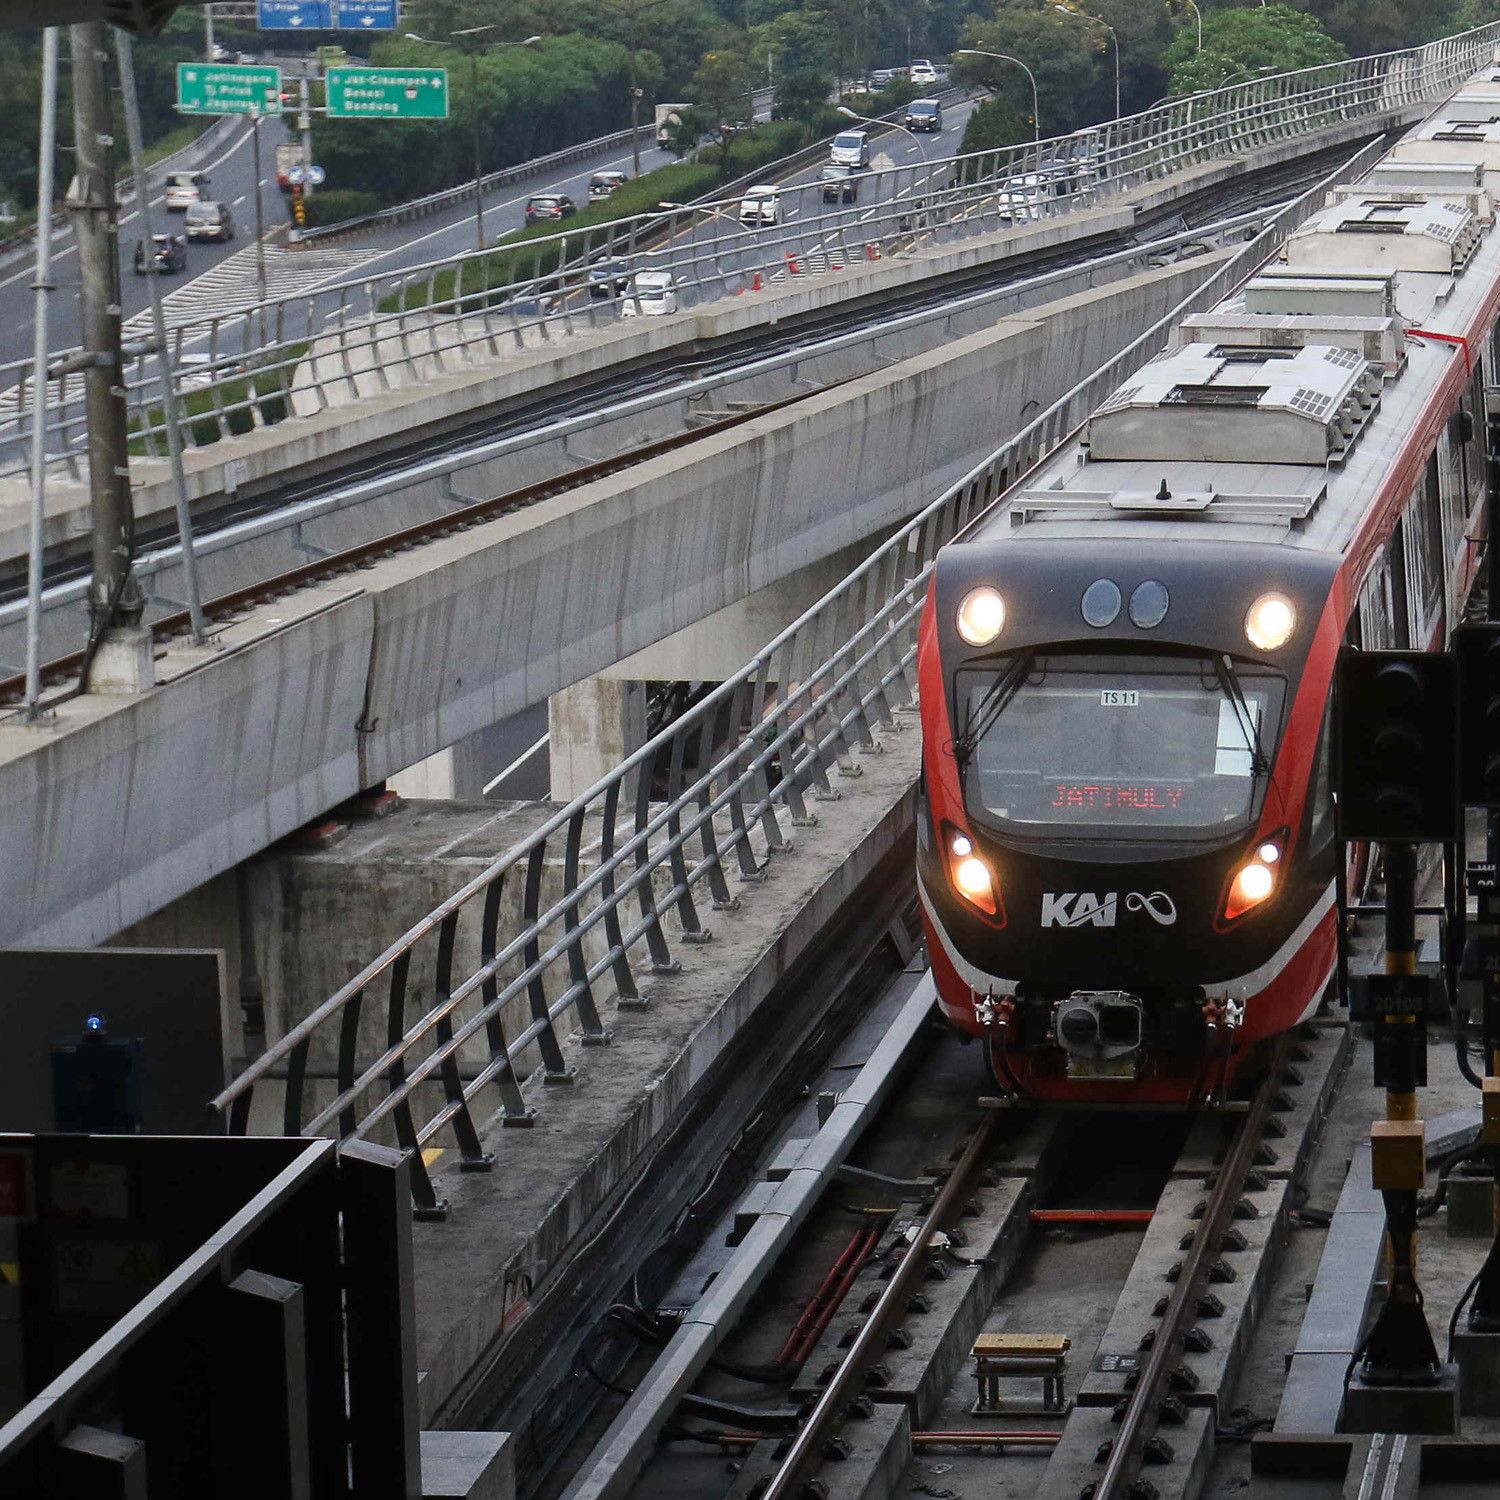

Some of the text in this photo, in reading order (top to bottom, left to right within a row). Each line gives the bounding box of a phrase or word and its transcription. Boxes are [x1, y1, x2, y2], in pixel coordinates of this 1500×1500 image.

[344, 87, 385, 98] Bekasi
[344, 101, 399, 113] Bandung
[1103, 692, 1137, 704] TS 11
[1041, 892, 1118, 928] KAI
